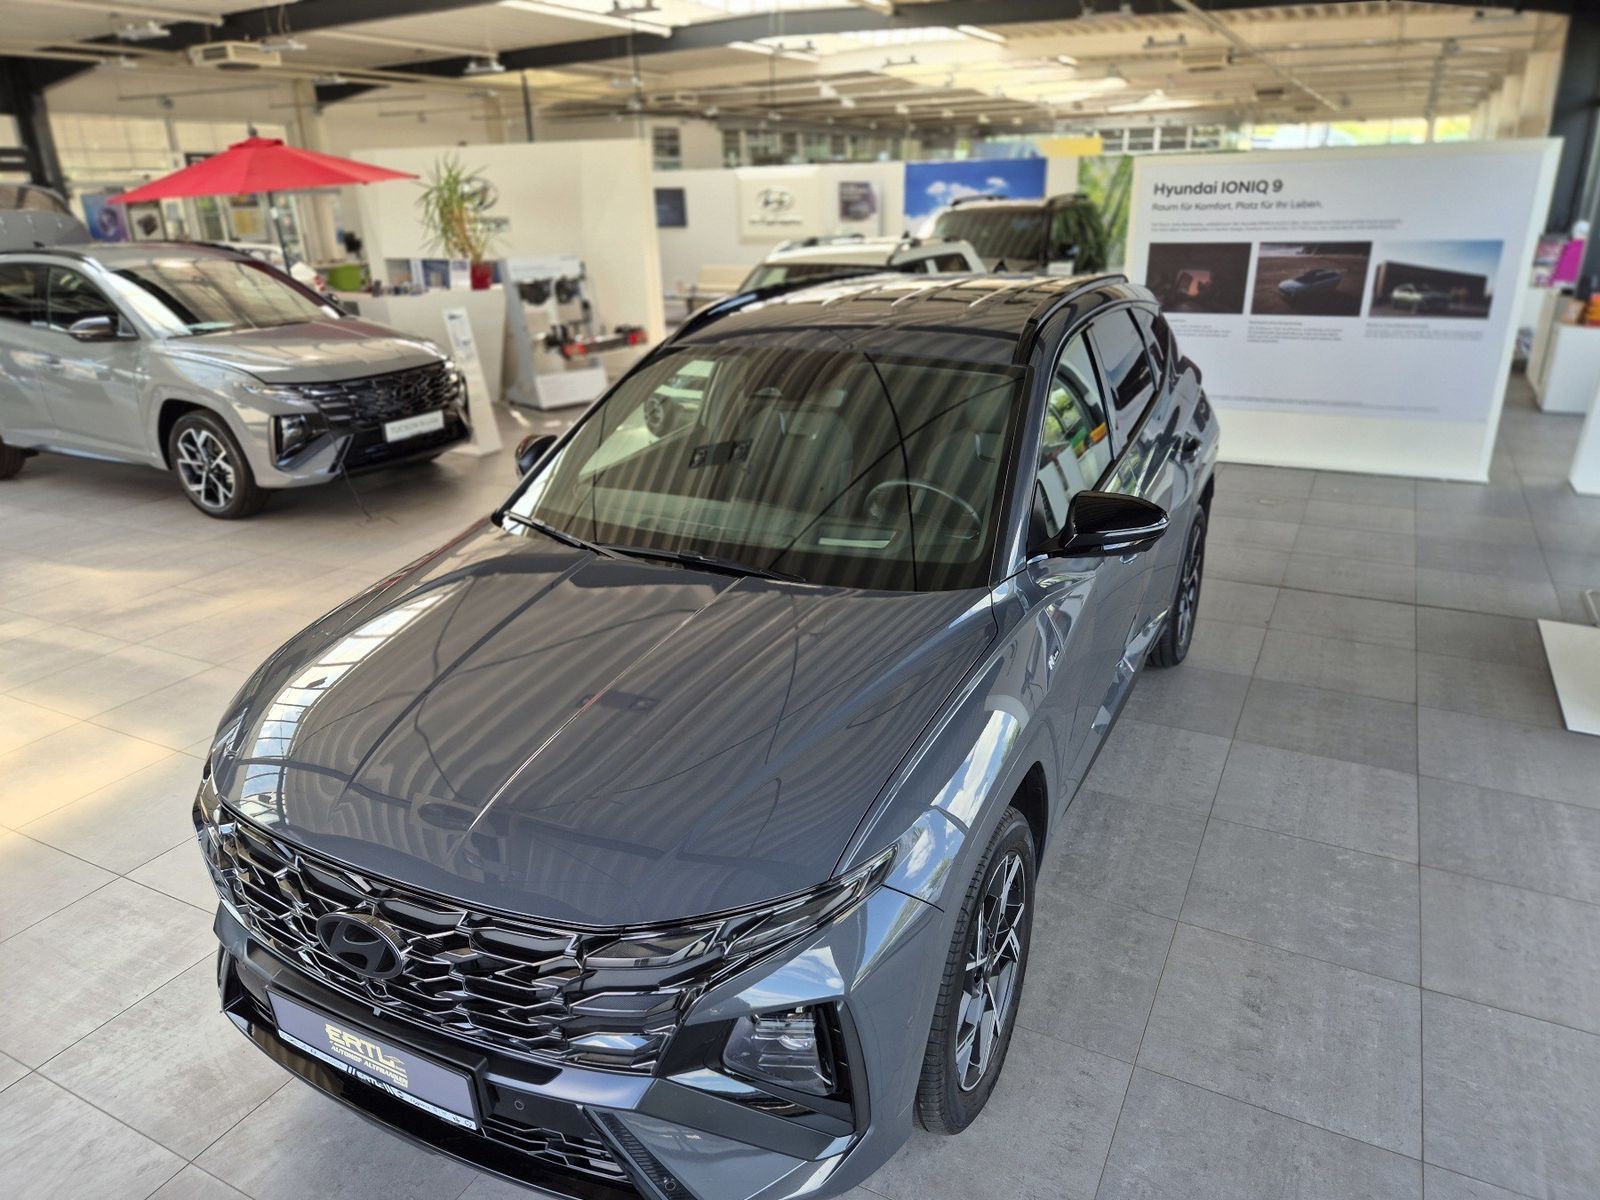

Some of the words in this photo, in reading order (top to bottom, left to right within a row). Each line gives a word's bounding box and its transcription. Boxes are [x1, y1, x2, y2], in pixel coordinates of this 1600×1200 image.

[1153, 181, 1218, 198] Hyundai
[1221, 179, 1269, 195] IONIQ
[1272, 179, 1283, 193] 9
[1151, 203, 1178, 212] Raum
[1180, 202, 1193, 211] für
[1235, 201, 1259, 210] Platz
[1260, 201, 1274, 210] für
[1275, 200, 1289, 209] Ihr
[325, 1023, 396, 1068] ERTL
[331, 1045, 362, 1063] AUTOHOF
